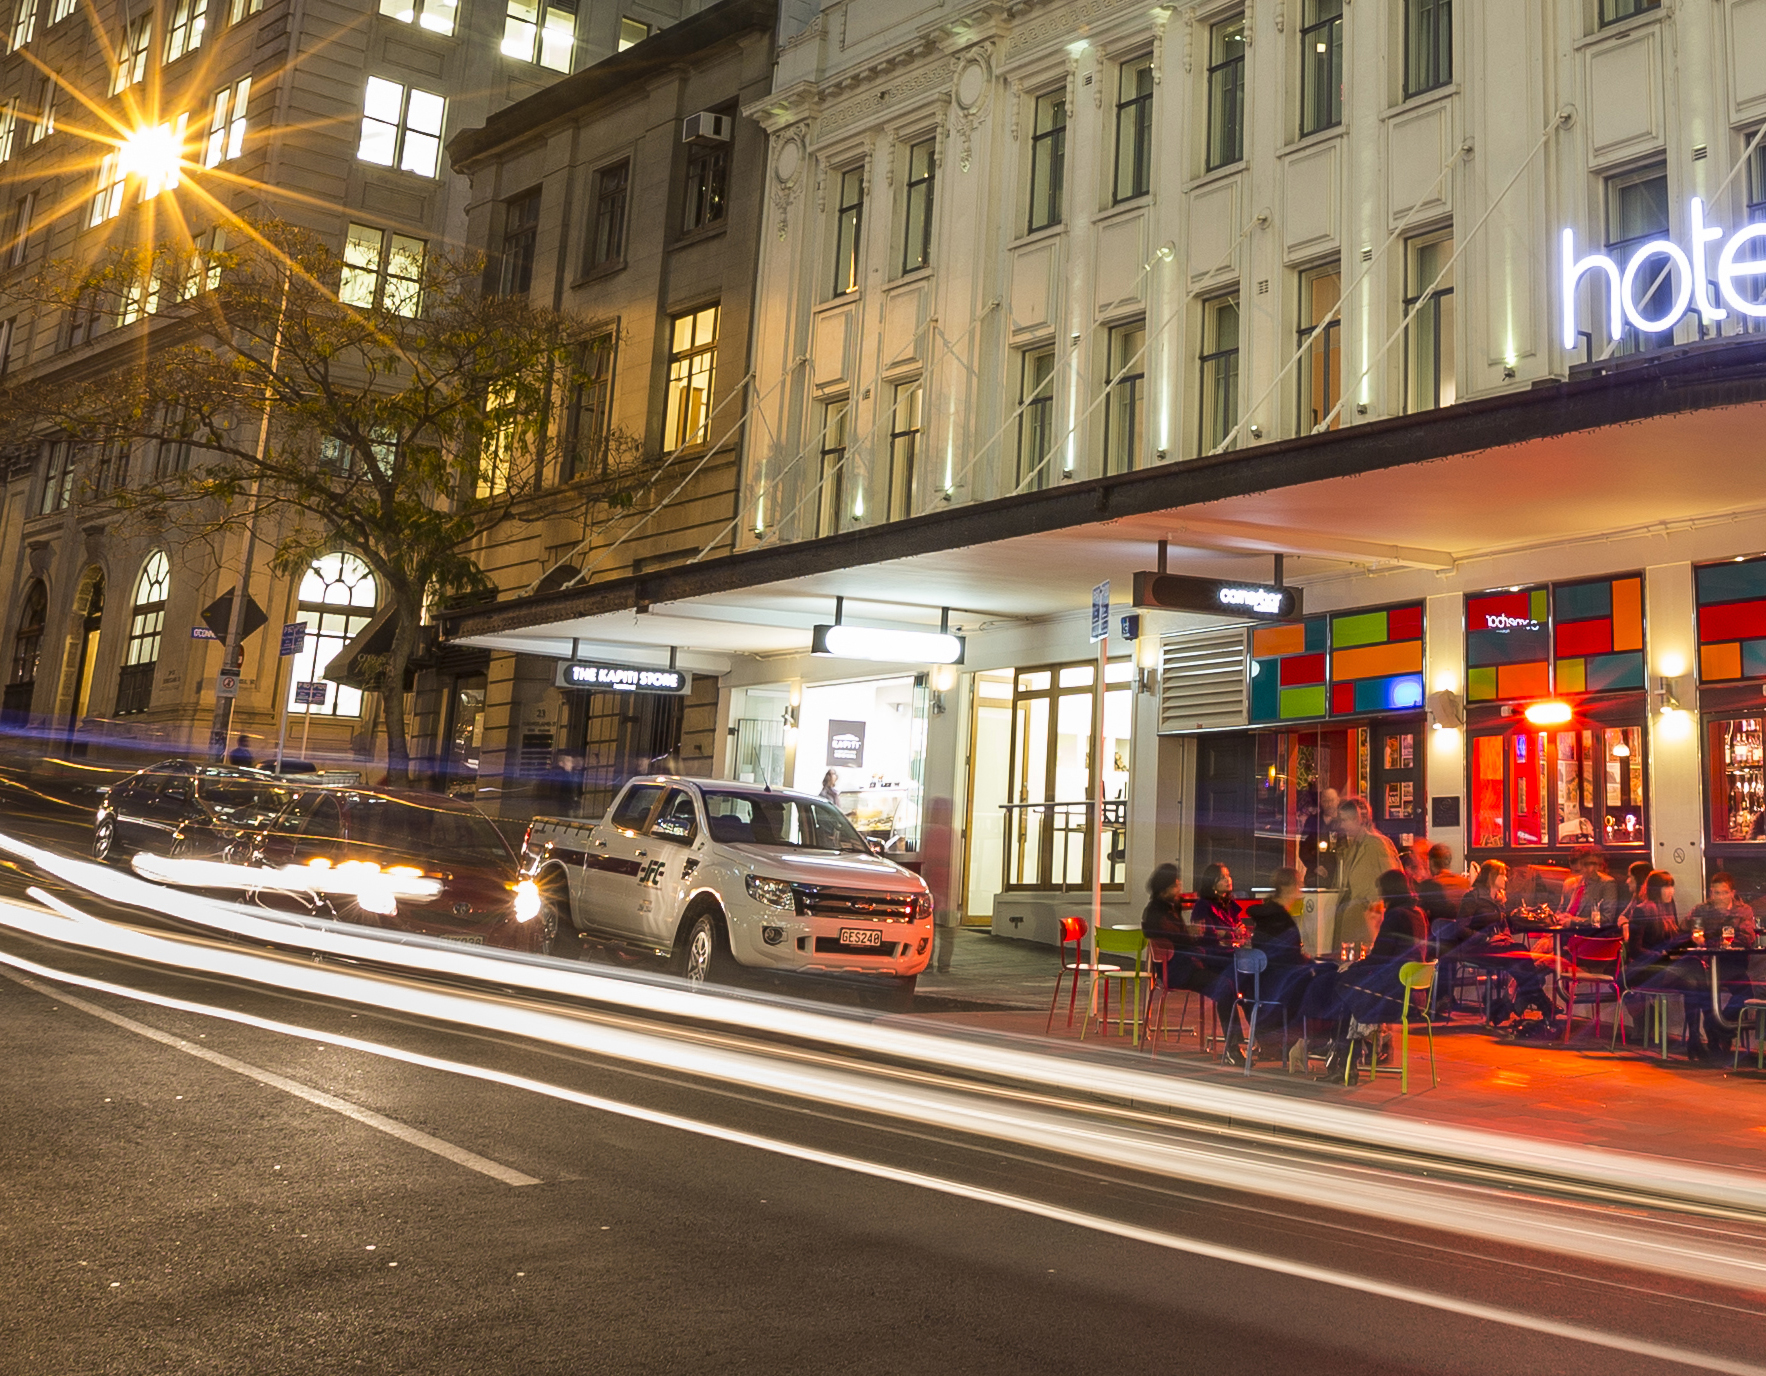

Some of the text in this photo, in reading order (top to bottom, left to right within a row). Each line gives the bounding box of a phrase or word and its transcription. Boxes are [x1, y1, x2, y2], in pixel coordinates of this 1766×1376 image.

[572, 666, 598, 682] THE
[598, 669, 638, 684] KAPITI
[639, 671, 678, 687] STORE
